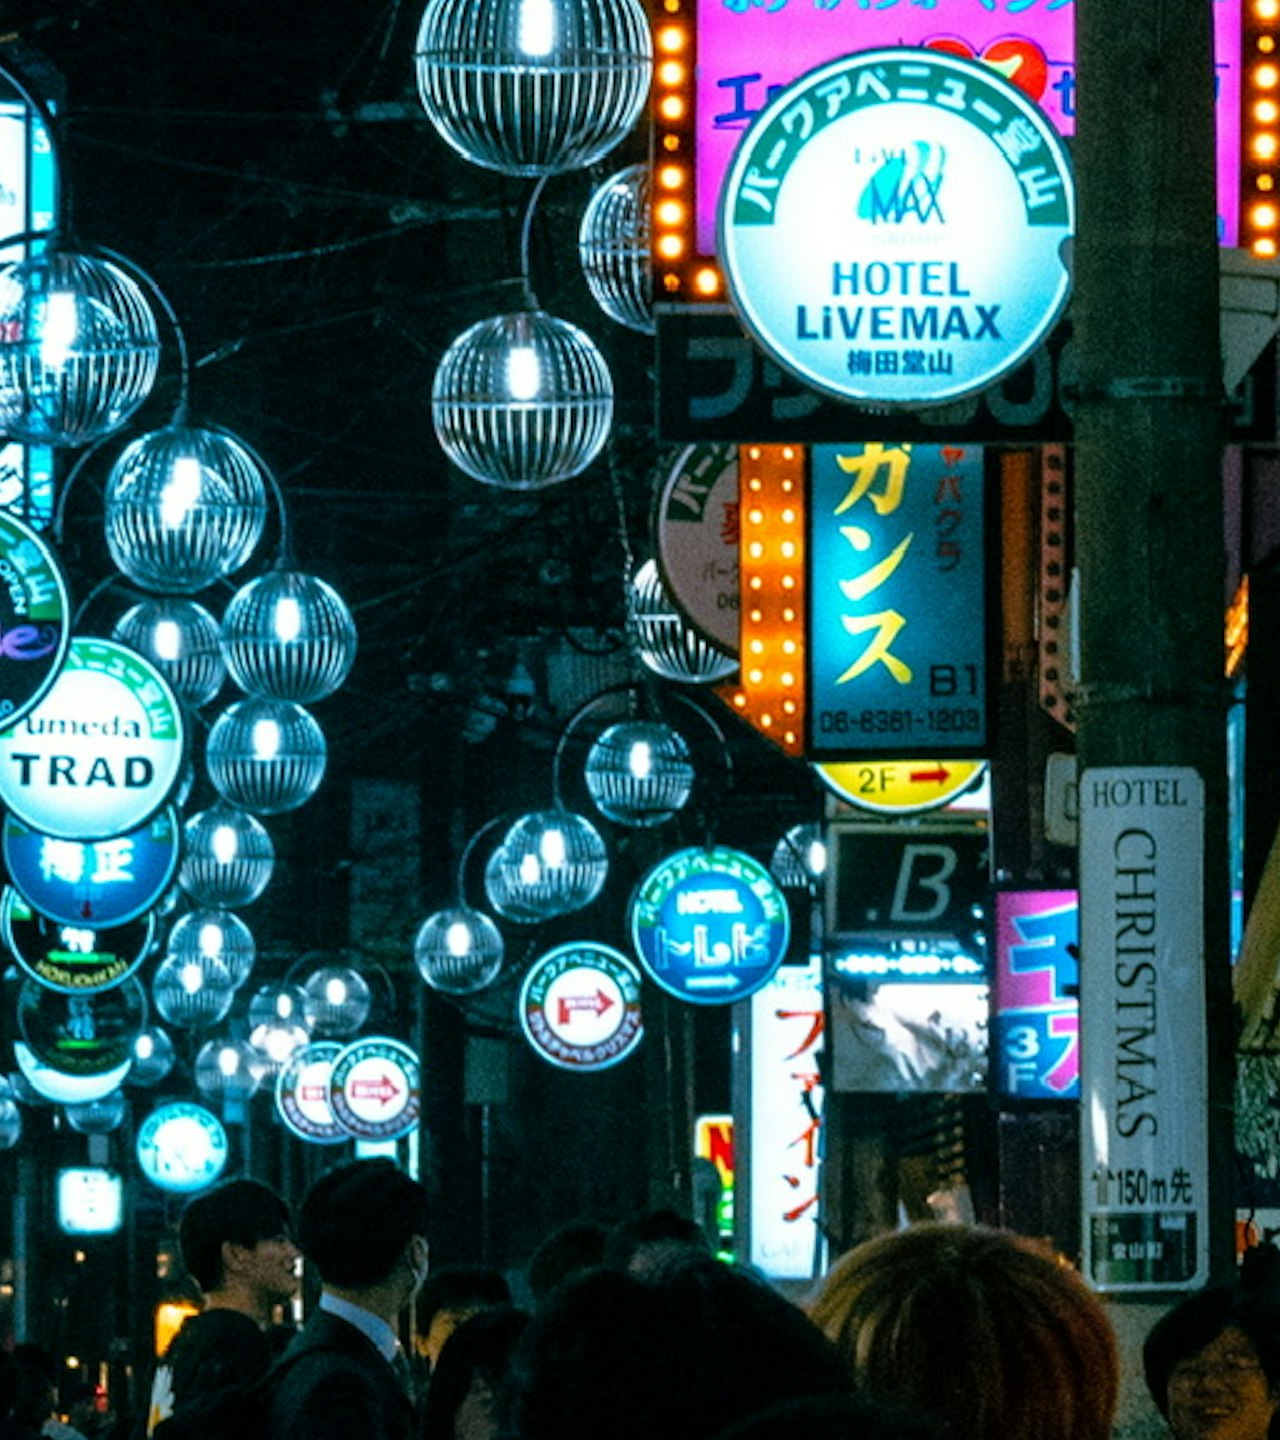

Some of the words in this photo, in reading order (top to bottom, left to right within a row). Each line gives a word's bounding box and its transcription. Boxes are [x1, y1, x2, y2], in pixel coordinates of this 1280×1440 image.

[738, 64, 1060, 212] パークアベニュー堂山
[831, 261, 971, 297] HOTEL
[847, 349, 954, 376] 梅田堂山
[928, 663, 978, 698] B1
[24, 715, 142, 739] umeda
[11, 753, 156, 789] TRAD
[858, 769, 896, 793] 2F
[1092, 779, 1188, 808] HOTEL
[1115, 827, 1157, 1140] CHRISTMAS
